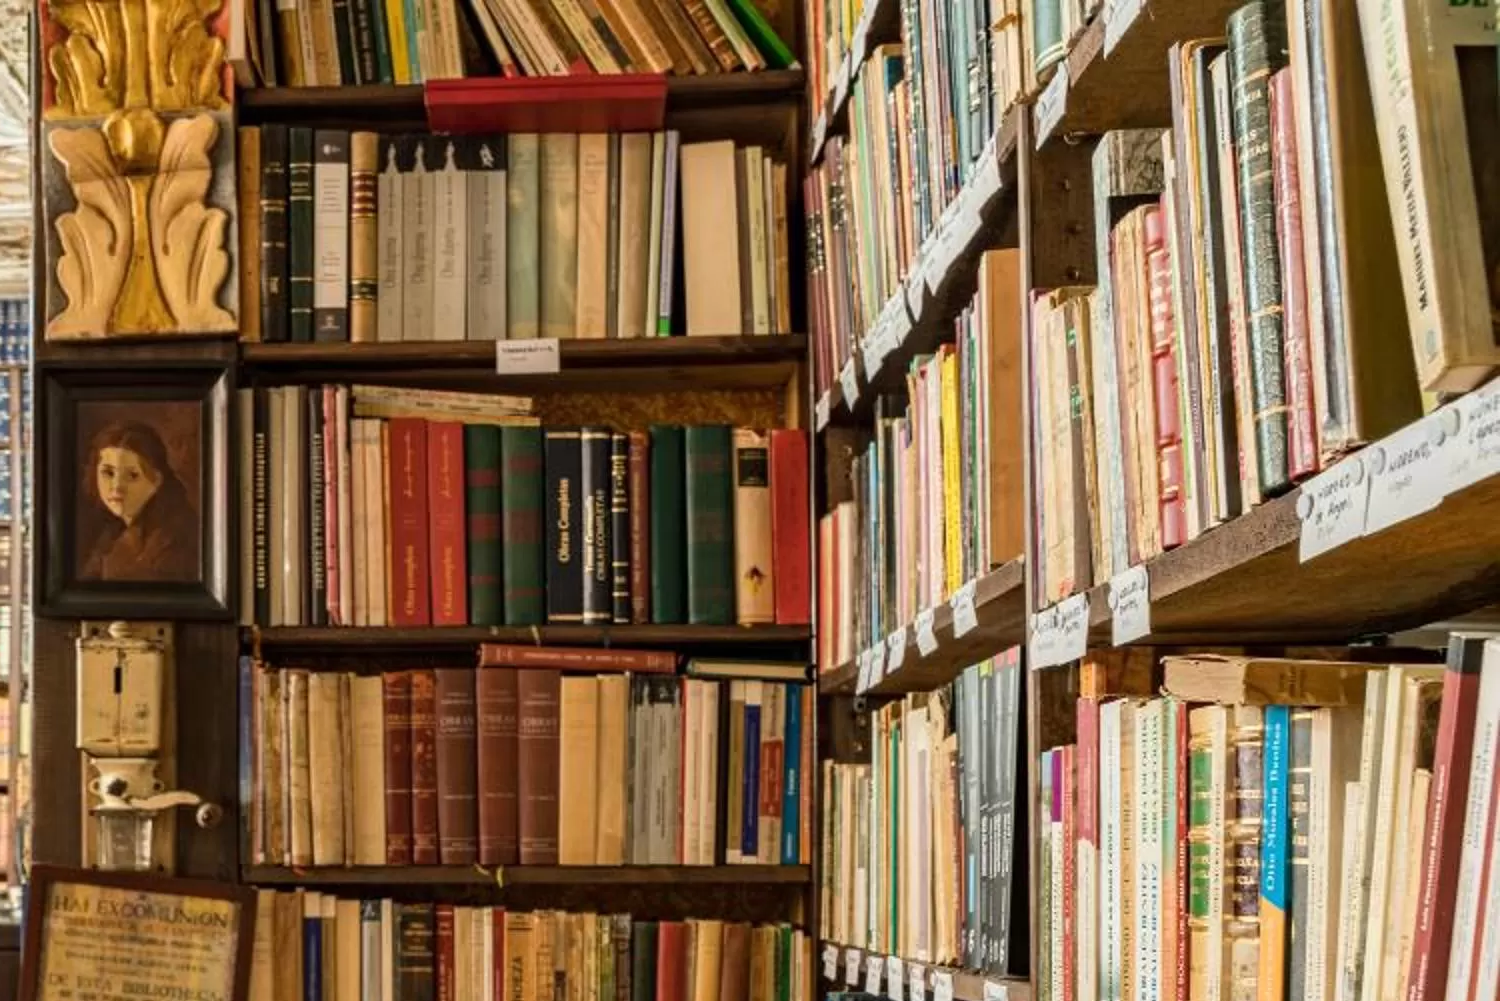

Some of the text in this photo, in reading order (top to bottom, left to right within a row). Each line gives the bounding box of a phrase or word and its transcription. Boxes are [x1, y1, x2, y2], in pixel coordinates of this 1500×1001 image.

[1411, 243, 1429, 311] MANUEL
[558, 478, 571, 562] Obras Completas
[1268, 788, 1278, 848] Morales
[1267, 854, 1275, 891] Otto
